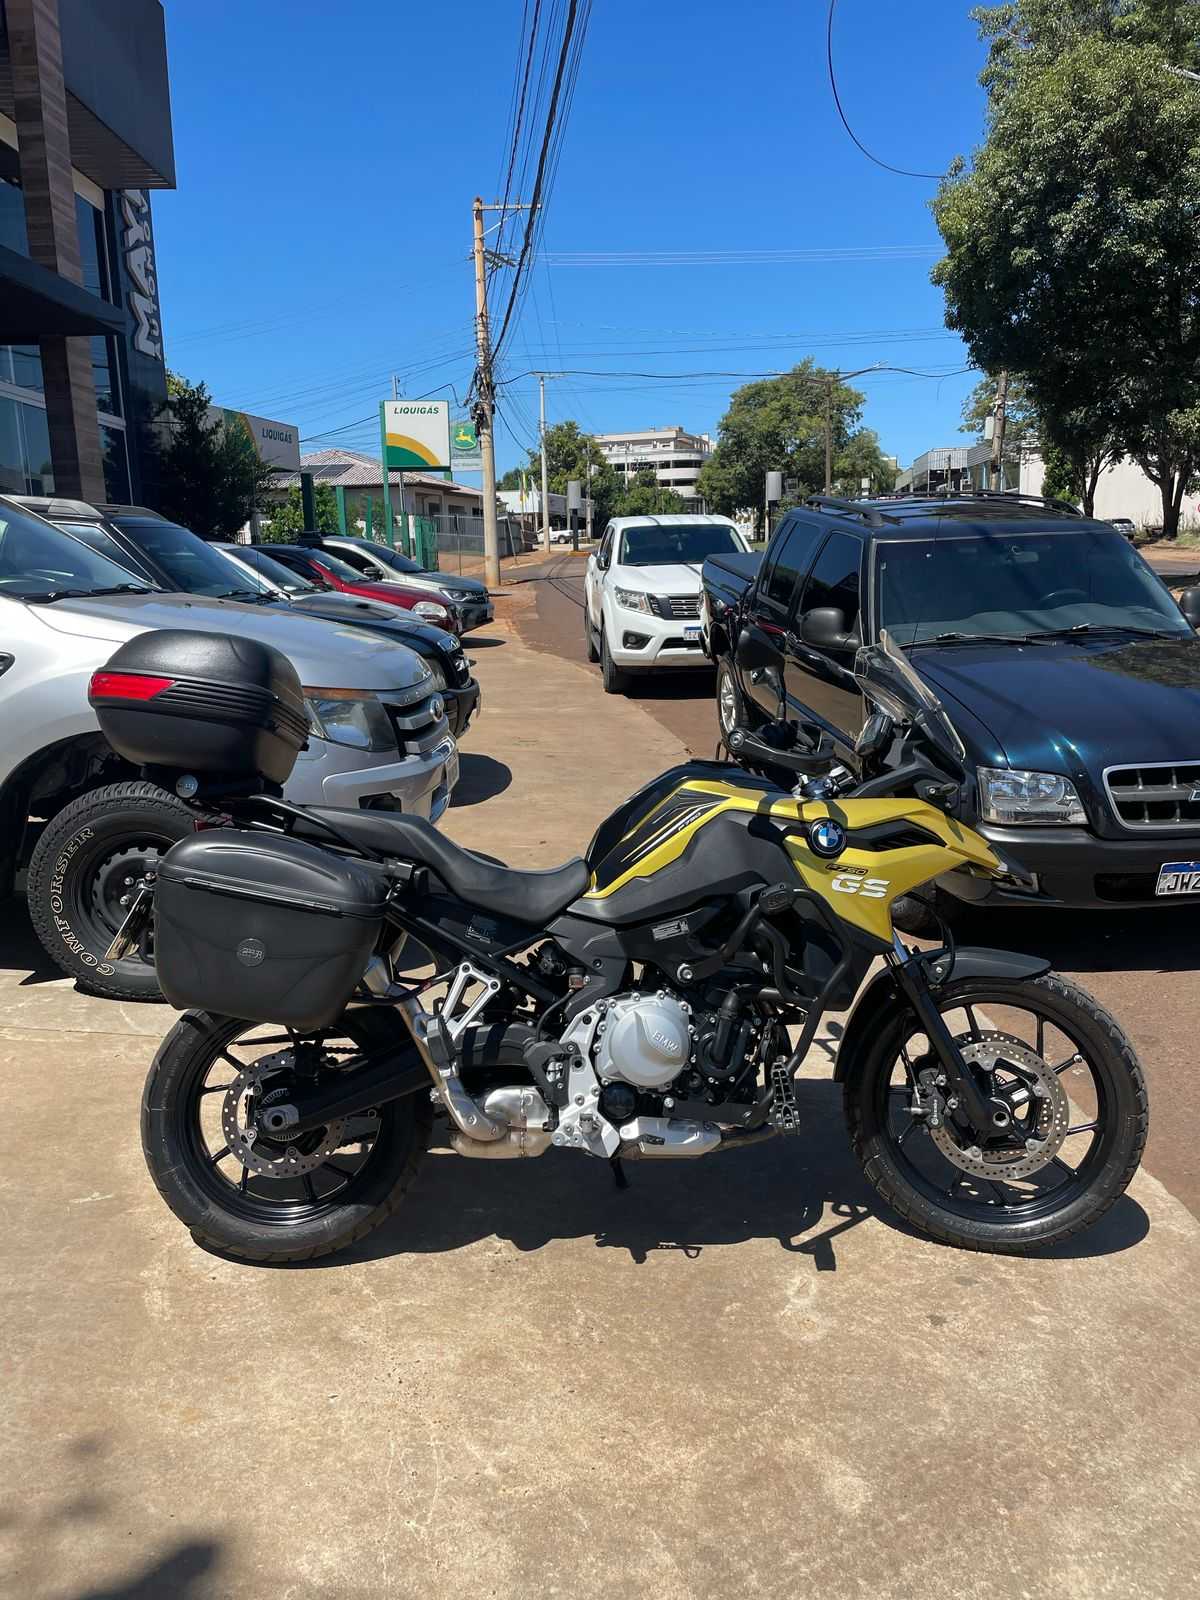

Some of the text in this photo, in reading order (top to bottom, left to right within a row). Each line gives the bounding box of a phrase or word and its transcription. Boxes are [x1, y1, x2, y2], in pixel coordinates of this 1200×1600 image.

[831, 873, 892, 898] GS
[51, 827, 116, 976] COMFORSER
[652, 1030, 679, 1050] BMW
